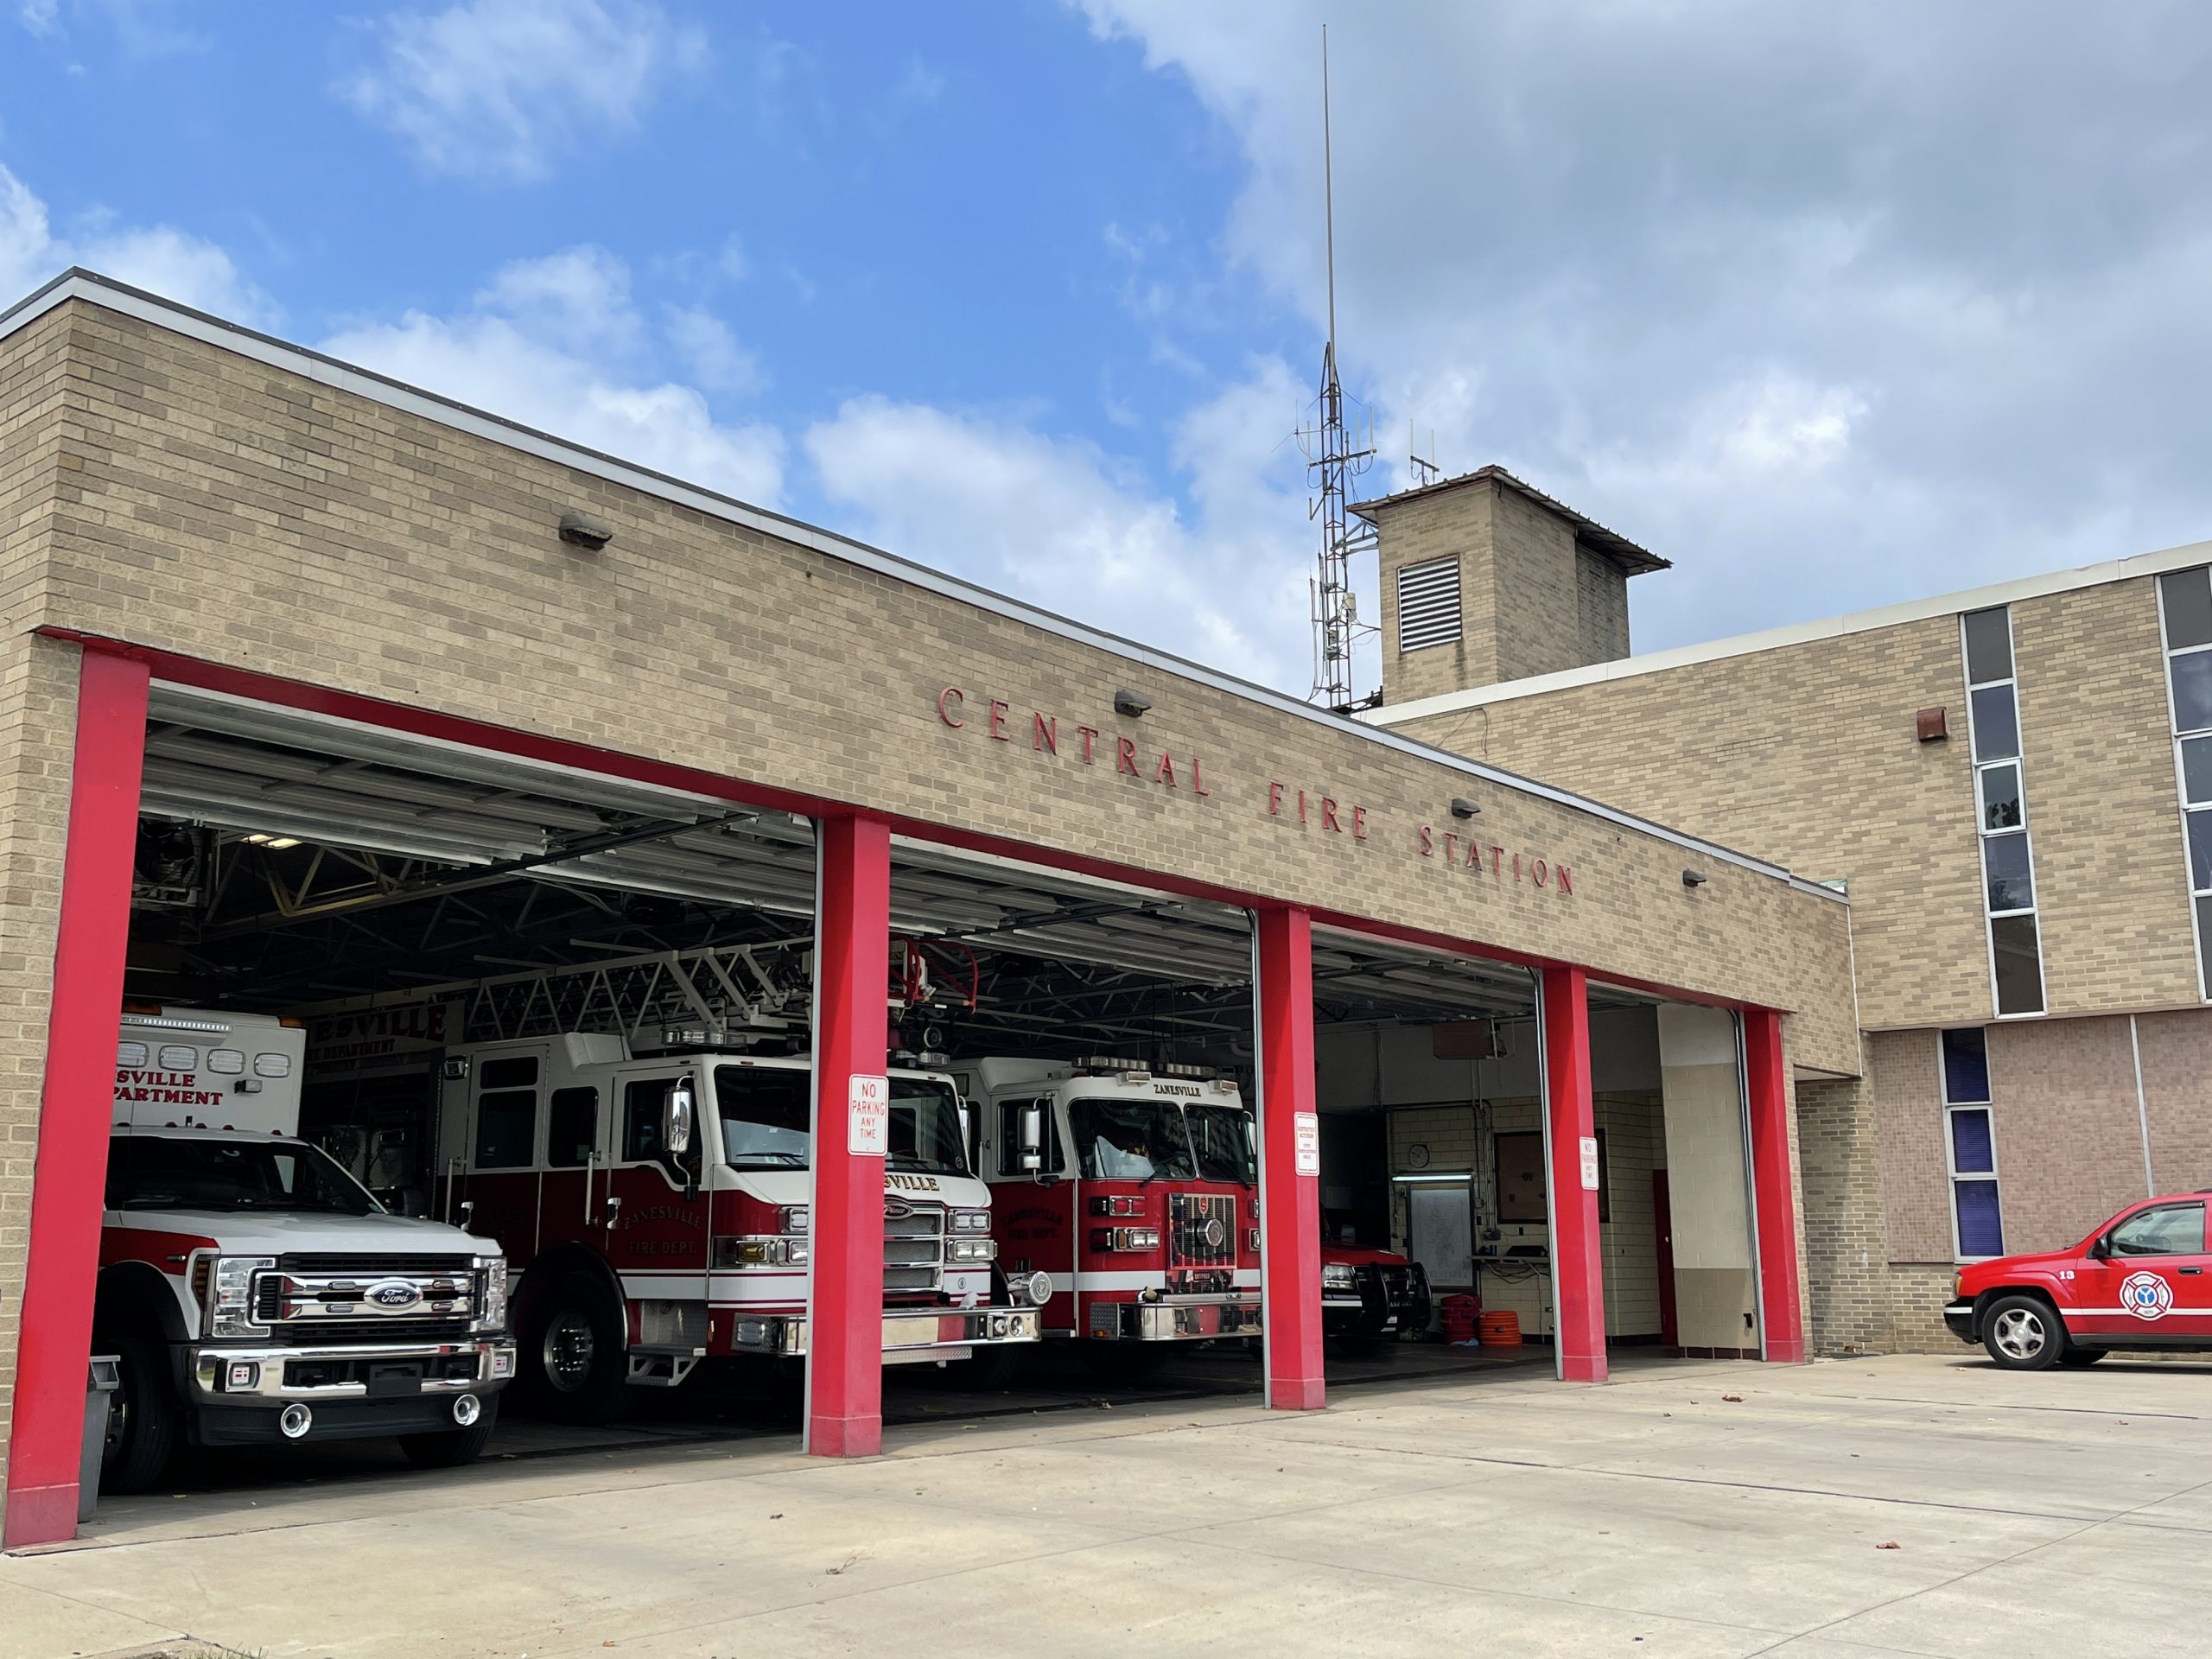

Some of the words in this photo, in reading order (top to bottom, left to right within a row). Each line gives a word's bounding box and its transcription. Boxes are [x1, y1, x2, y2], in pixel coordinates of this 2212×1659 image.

[938, 685, 1211, 797] CENTRAL
[1269, 781, 1369, 840] FIRE
[1419, 825, 1573, 896] STATION
[861, 1084, 876, 1098] NO
[1154, 1084, 1202, 1097] ZANESVILLE
[852, 1100, 885, 1116] PARKING
[861, 1117, 876, 1127] ANY
[861, 1128, 876, 1140] TIME
[622, 1205, 702, 1230] ZANESVILLE
[628, 1241, 657, 1255] FIRE
[2059, 1270, 2075, 1281] 13
[381, 1289, 410, 1303] Ford
